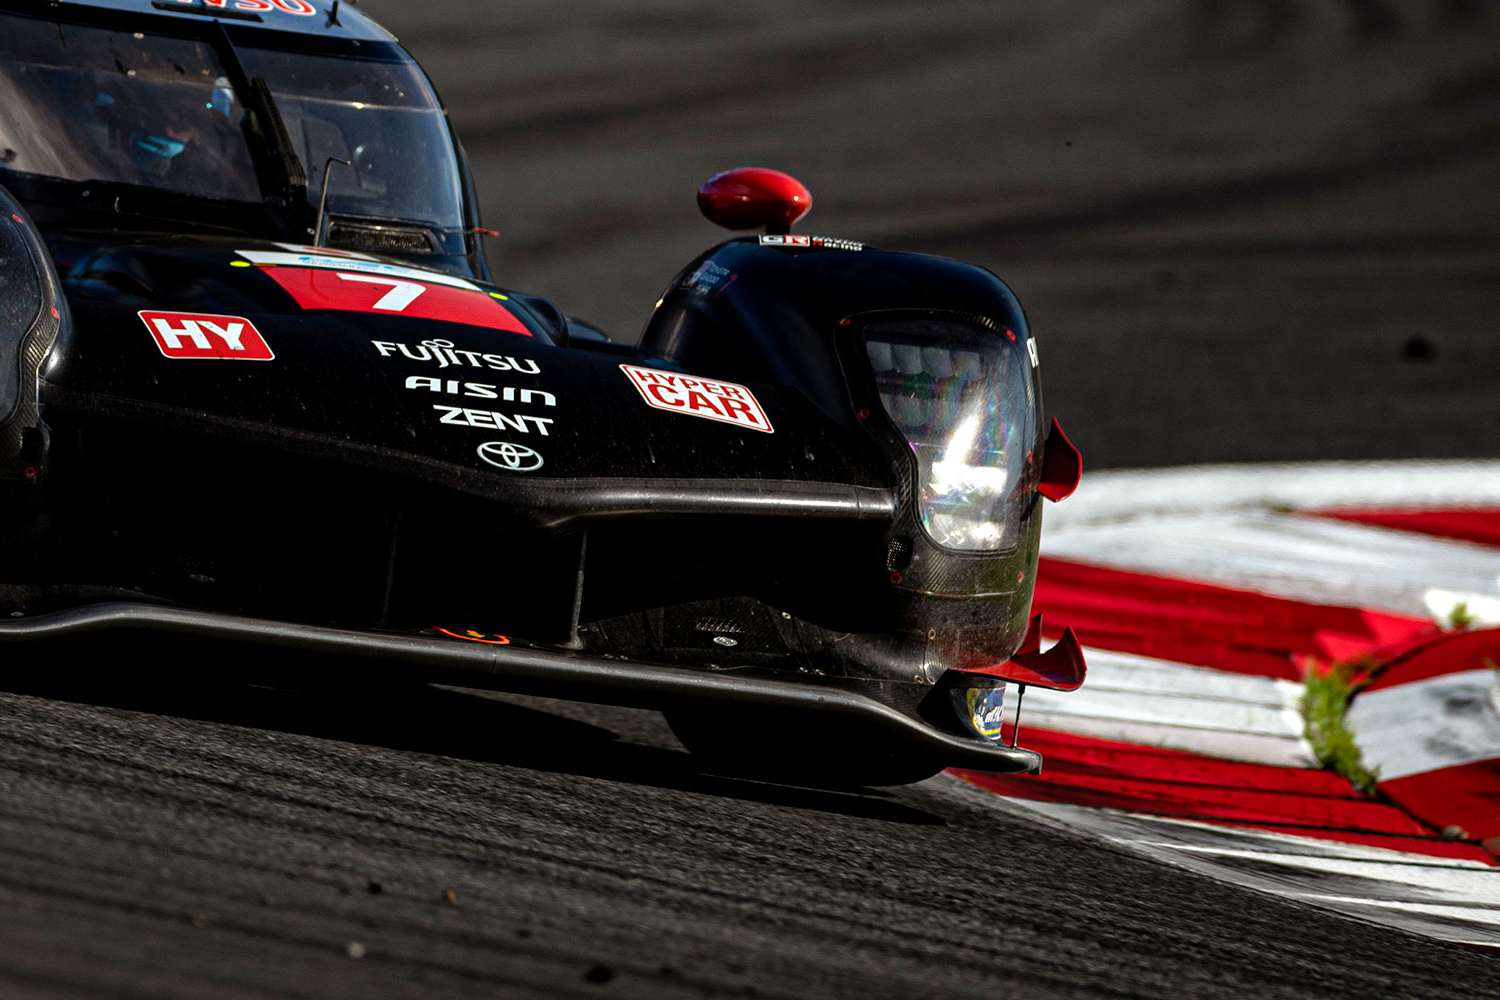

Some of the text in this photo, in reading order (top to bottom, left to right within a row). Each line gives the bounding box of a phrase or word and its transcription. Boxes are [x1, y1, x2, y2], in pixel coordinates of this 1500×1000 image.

[336, 272, 427, 312] 7
[150, 318, 245, 351] HY
[371, 338, 541, 375] FUJITSU
[404, 375, 557, 407] AISIN
[633, 369, 745, 400] HYPER
[432, 404, 554, 437] ZENT
[647, 383, 760, 425] CAR
